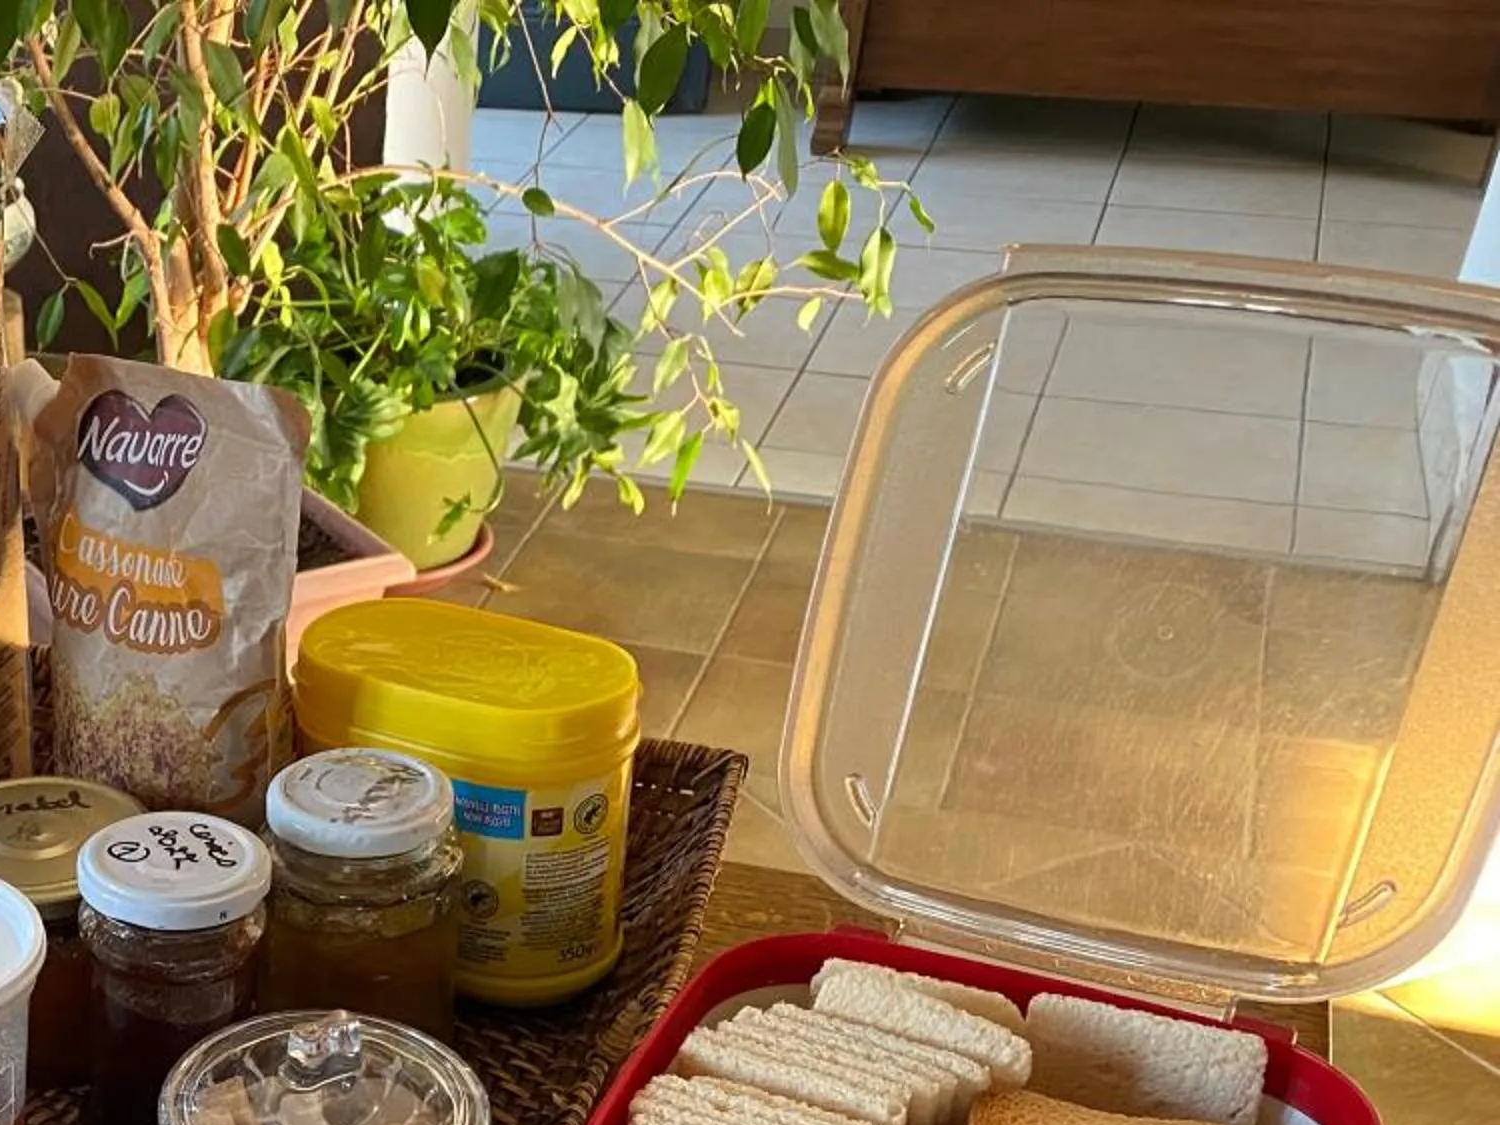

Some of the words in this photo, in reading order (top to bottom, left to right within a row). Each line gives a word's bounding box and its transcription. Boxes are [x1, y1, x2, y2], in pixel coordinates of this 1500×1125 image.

[77, 415, 202, 470] Navarre
[50, 574, 100, 626] ure
[108, 586, 212, 647] Canne
